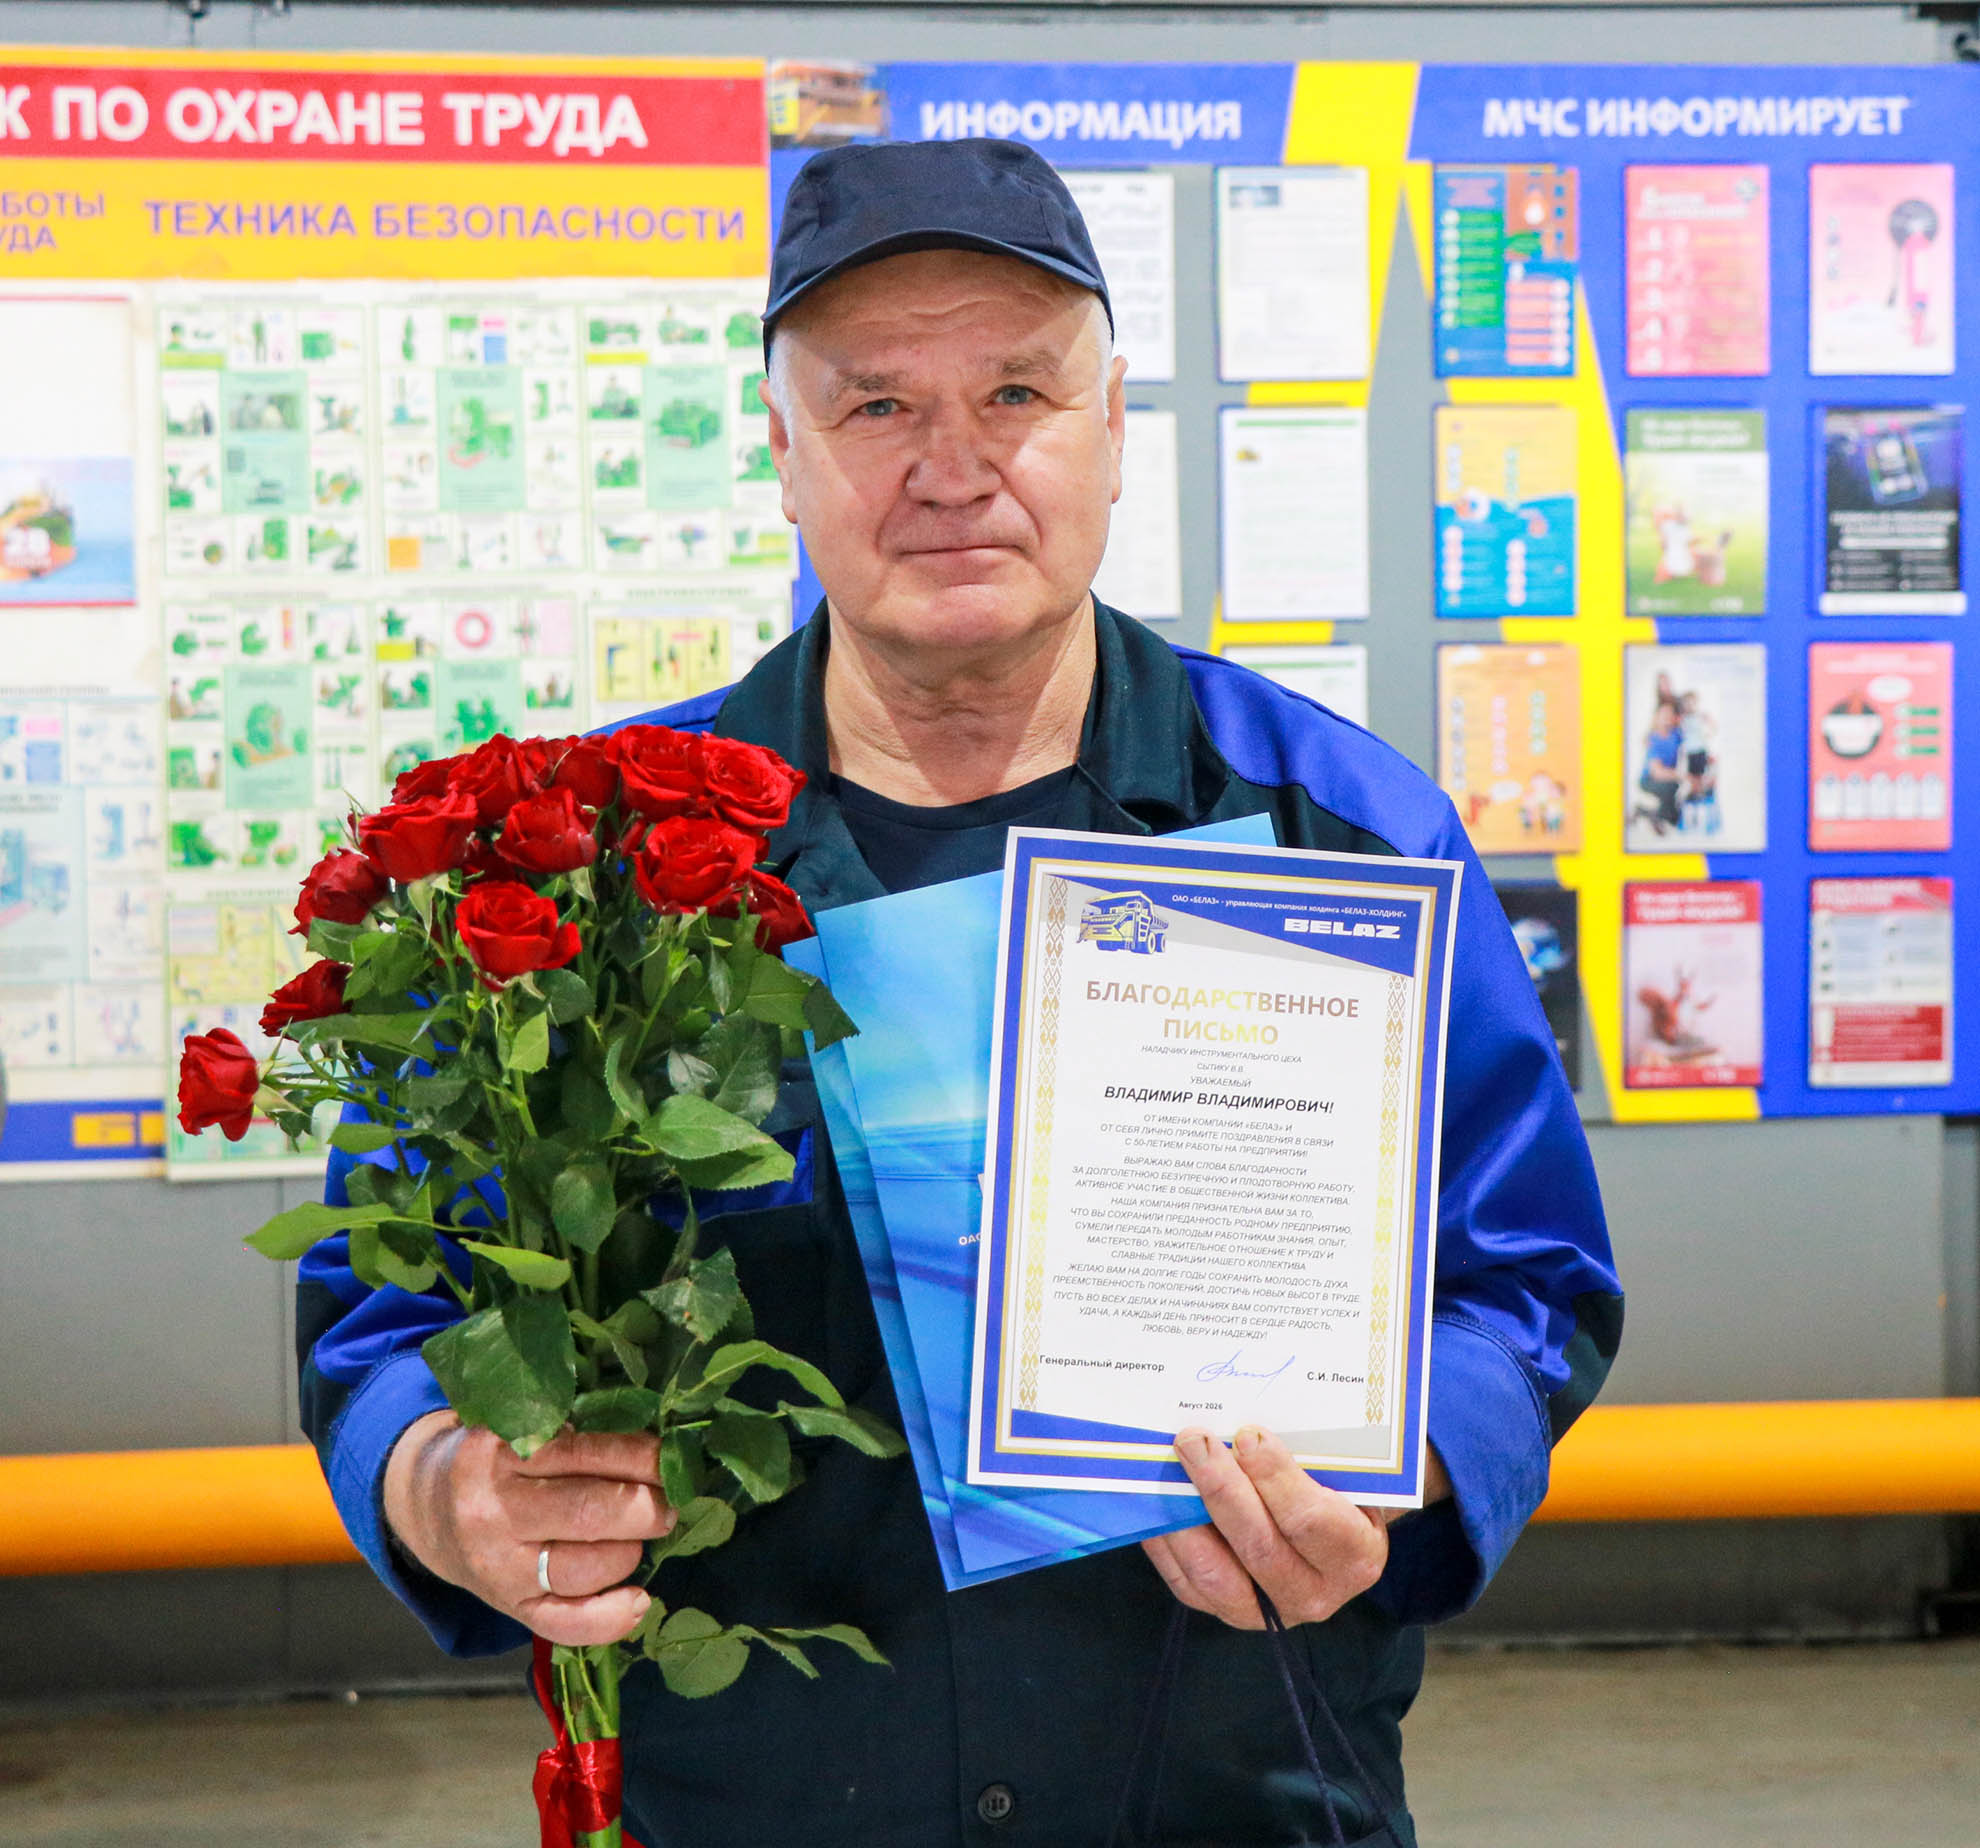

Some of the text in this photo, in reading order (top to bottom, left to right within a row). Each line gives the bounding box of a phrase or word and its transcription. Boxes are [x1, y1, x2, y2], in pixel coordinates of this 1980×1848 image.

[0, 85, 649, 157] К ПО ОХРАНЕ ТРУДА
[920, 100, 1242, 149] ИНФОРМАЦИЯ
[1483, 95, 1909, 138] МЧС ИНФОРМИРУЕТ
[145, 201, 744, 241] ТЕХНИКА БЕЗОПАСНОСТИ
[1225, 900, 1273, 909] управляющая
[1274, 903, 1307, 911] компания
[1309, 905, 1339, 914] холдинга
[1284, 918, 1400, 939] BELAZ
[1086, 980, 1360, 1018] БЛАГОДАРСТВЕННОЕ
[1163, 1018, 1279, 1045] ПИСЬМО
[1141, 1045, 1302, 1064] НАЛАДЧИКУ ИНСТРУМЕНТАЛЬНОГО ЦЕХА
[1190, 1075, 1251, 1088] УВАЖАЕМЫЙ
[1104, 1087, 1334, 1113] ВЛАДИМИР ВЛАДИМИРОВИЧ!
[1143, 1114, 1156, 1122] ОТ
[1158, 1115, 1190, 1125] ИМЕНИ
[1192, 1117, 1243, 1128] КОМПАНИИ
[1100, 1123, 1113, 1132] ОТ
[1115, 1124, 1140, 1134] СЕБЯ
[1142, 1126, 1173, 1136] ЛИЧНО
[1175, 1128, 1218, 1139] ПРИМИТЕ
[1220, 1131, 1293, 1145] ПОЗДРАВЛЕНИЯ
[1303, 1137, 1334, 1147] СВЯЗИ
[1134, 1138, 1183, 1149] 50-ЛЕТИЕМ
[1185, 1142, 1223, 1152] РАБОТЫ
[1224, 1144, 1237, 1152] НА
[1124, 1156, 1307, 1177] ВЫРАЖАЮ ВАМ СЛОВА БЛАГОДАРНОСТИ
[1072, 1166, 1084, 1174] ЗА
[1086, 1167, 1159, 1180] ДОЛГОЛЕТНЮЮ
[1161, 1172, 1229, 1184] БЕЗУПРЕЧНУЮ
[1239, 1177, 1316, 1191] ПЛОДОТВОРНУЮ
[1076, 1179, 1124, 1190] АКТИВНОЕ
[1127, 1183, 1167, 1193] УЧАСТИЕ
[1178, 1185, 1254, 1200] ОБЩЕСТВЕННОЙ
[1256, 1191, 1288, 1201] ЖИЗНИ
[1111, 1197, 1137, 1207] НАША
[1139, 1199, 1190, 1210] КОМПАНИЯ
[1192, 1202, 1262, 1215] ПРИЗНАТЕЛЬНА
[1265, 1207, 1284, 1216] ВАМ
[1286, 1208, 1297, 1217] ЗА
[1070, 1208, 1089, 1217] ЧТО
[1091, 1209, 1105, 1218] ВЫ
[1107, 1210, 1164, 1222] СОХРАНИЛИ
[1165, 1214, 1232, 1227] ПРЕДАННОСТЬ
[1234, 1218, 1280, 1230] РОДНОМУ
[1075, 1222, 1113, 1232] СУМЕЛИ
[1115, 1224, 1162, 1236] ПЕРЕДАТЬ
[1164, 1228, 1213, 1240] МОЛОДЫМ
[1214, 1231, 1275, 1243] РАБОТНИКАМ
[1111, 1250, 1155, 1261] СЛАВНЫЕ
[1158, 1253, 1206, 1265] ТРАДИЦИИ
[1208, 1256, 1246, 1266] НАШЕГО
[1154, 1240, 1226, 1253] УВАЖИТЕЛЬНОЕ
[1228, 1245, 1286, 1256] ОТНОШЕНИЕ
[1297, 1249, 1326, 1260] ТРУДУ
[1068, 1263, 1104, 1273] ЖЕЛАЮ
[1106, 1266, 1126, 1275] ВАМ
[1128, 1267, 1140, 1275] НА
[1142, 1268, 1178, 1279] ДОЛГИЕ
[1180, 1270, 1206, 1281] ГОДЫ
[1208, 1272, 1262, 1283] СОХРАНИТЬ
[1265, 1275, 1322, 1288] МОЛОДОСТЬ
[1052, 1275, 1146, 1289] ПРЕЕМСТВЕННОСТЬ
[1208, 1285, 1251, 1296] ДОСТИЧЬ
[1252, 1288, 1286, 1297] НОВЫХ
[1288, 1290, 1320, 1299] ВЫСОТ
[1054, 1291, 1084, 1301] ПУСТЬ
[1086, 1293, 1100, 1302] ВО
[1101, 1294, 1126, 1303] ВСЕХ
[1127, 1296, 1158, 1306] ДЕЛАХ
[1168, 1298, 1230, 1310] НАЧИНАНИЯХ
[1231, 1302, 1251, 1311] ВАМ
[1253, 1304, 1318, 1315] СОПУТСТВУЕТ
[1320, 1308, 1351, 1317] УСПЕХ
[1121, 1308, 1161, 1320] КАЖДЫЙ
[1163, 1311, 1187, 1322] ДЕНЬ
[1189, 1313, 1239, 1324] ПРИНОСИТ
[1249, 1317, 1286, 1328] СЕРДЦЕ
[1186, 1326, 1211, 1335] ВЕРУ
[1039, 1355, 1165, 1372] Генеральный директор
[1307, 1371, 1364, 1384] С.И. Лесин
[1178, 1401, 1203, 1410] Август
